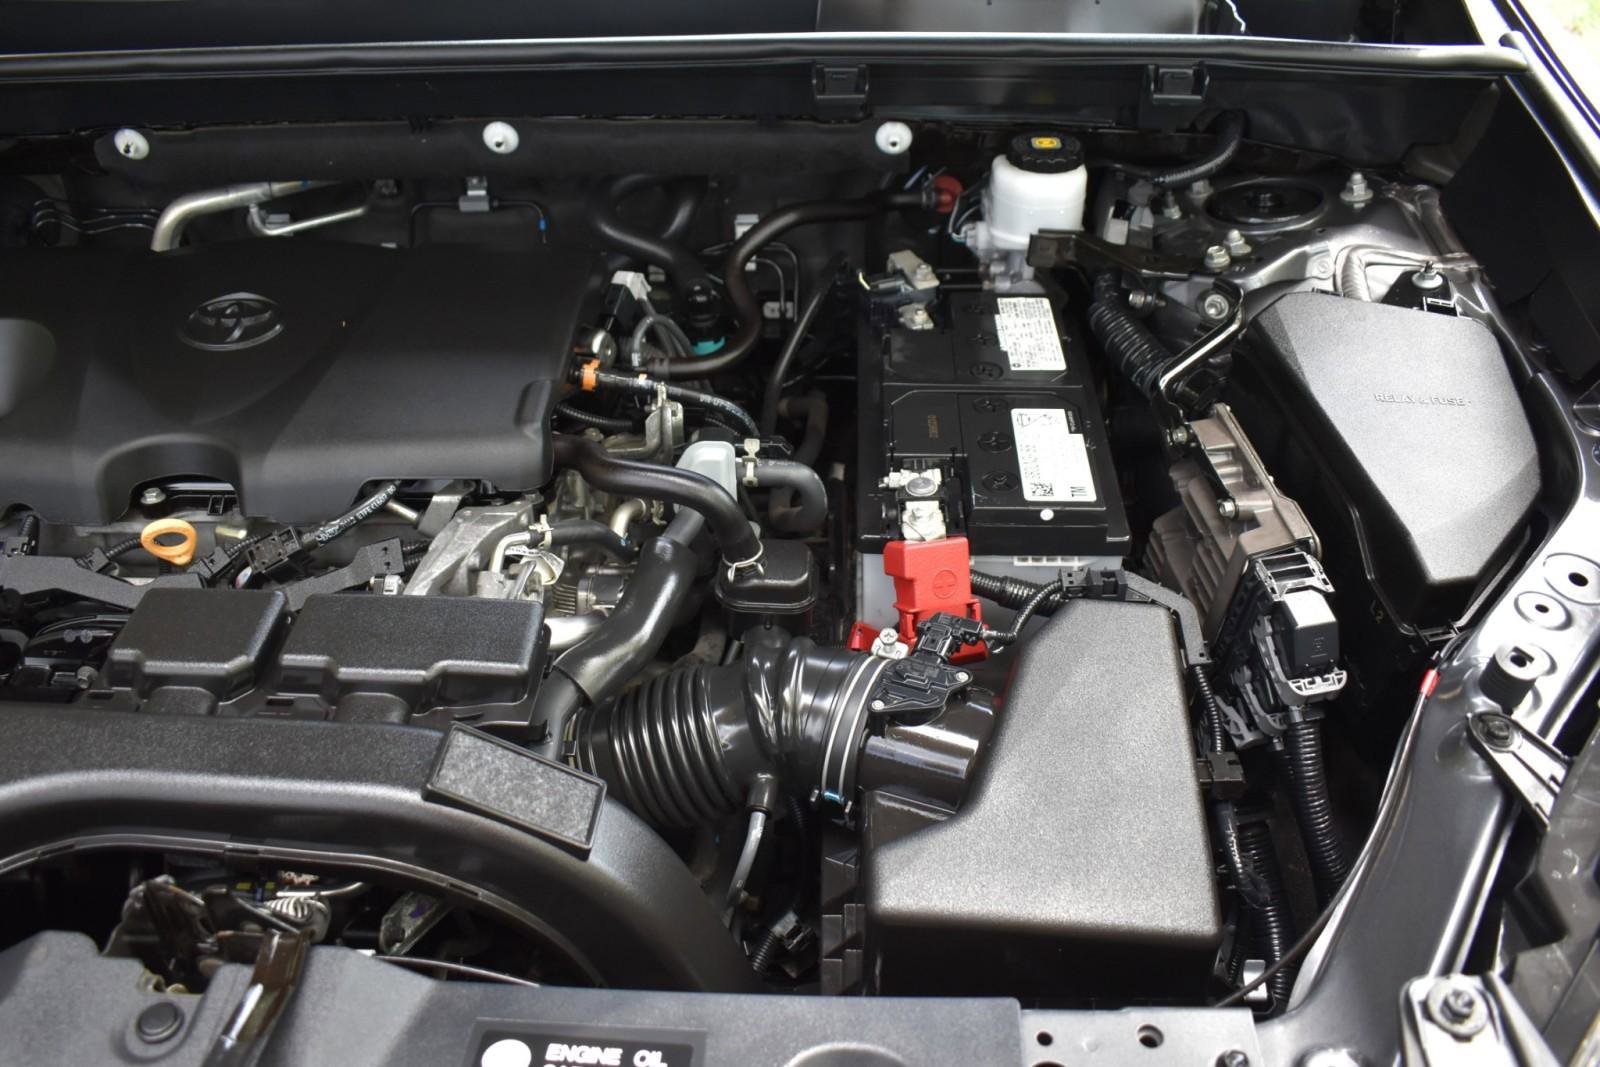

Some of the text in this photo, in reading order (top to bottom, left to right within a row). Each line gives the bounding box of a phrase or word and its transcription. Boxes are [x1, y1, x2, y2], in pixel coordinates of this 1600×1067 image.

[1374, 393, 1415, 405] RELAY
[1431, 396, 1465, 407] FUSE
[545, 1043, 668, 1067] ENGINE OIL
